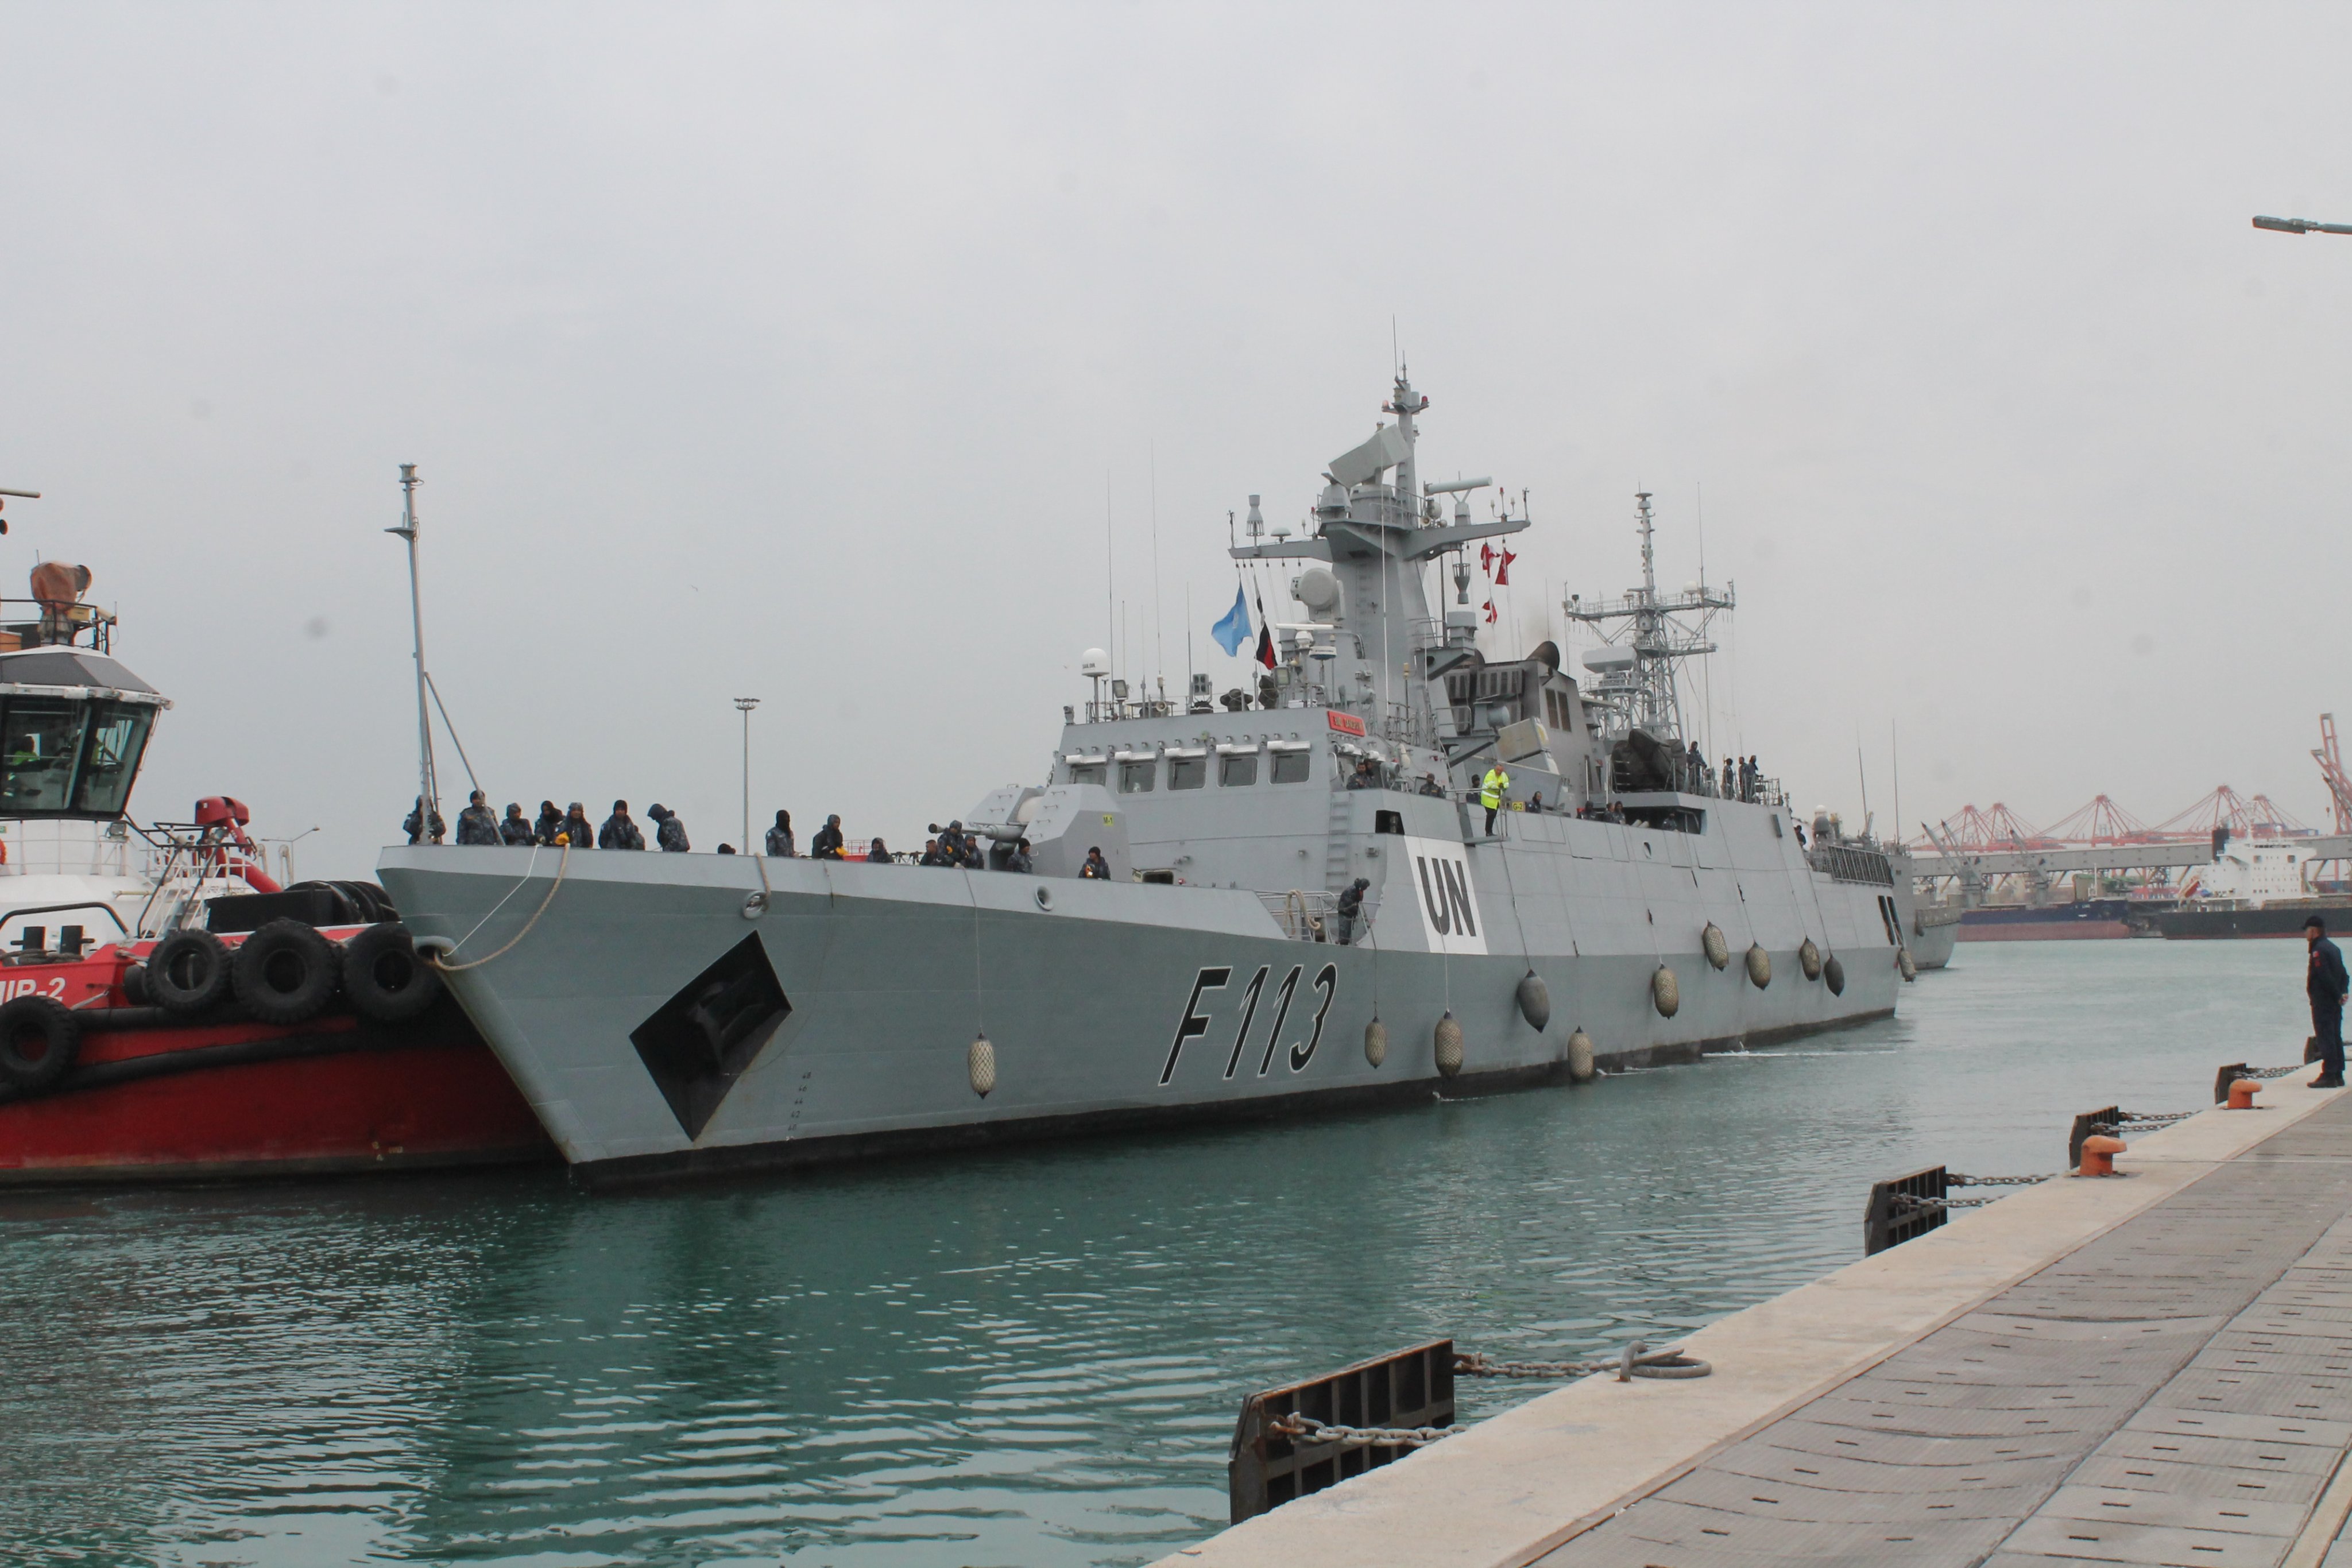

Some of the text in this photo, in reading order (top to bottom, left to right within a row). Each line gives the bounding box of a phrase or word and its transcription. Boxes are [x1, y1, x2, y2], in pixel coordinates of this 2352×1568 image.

[1103, 816, 1113, 824] M-1
[1417, 856, 1476, 937] UN
[1158, 962, 1337, 1086] F113
